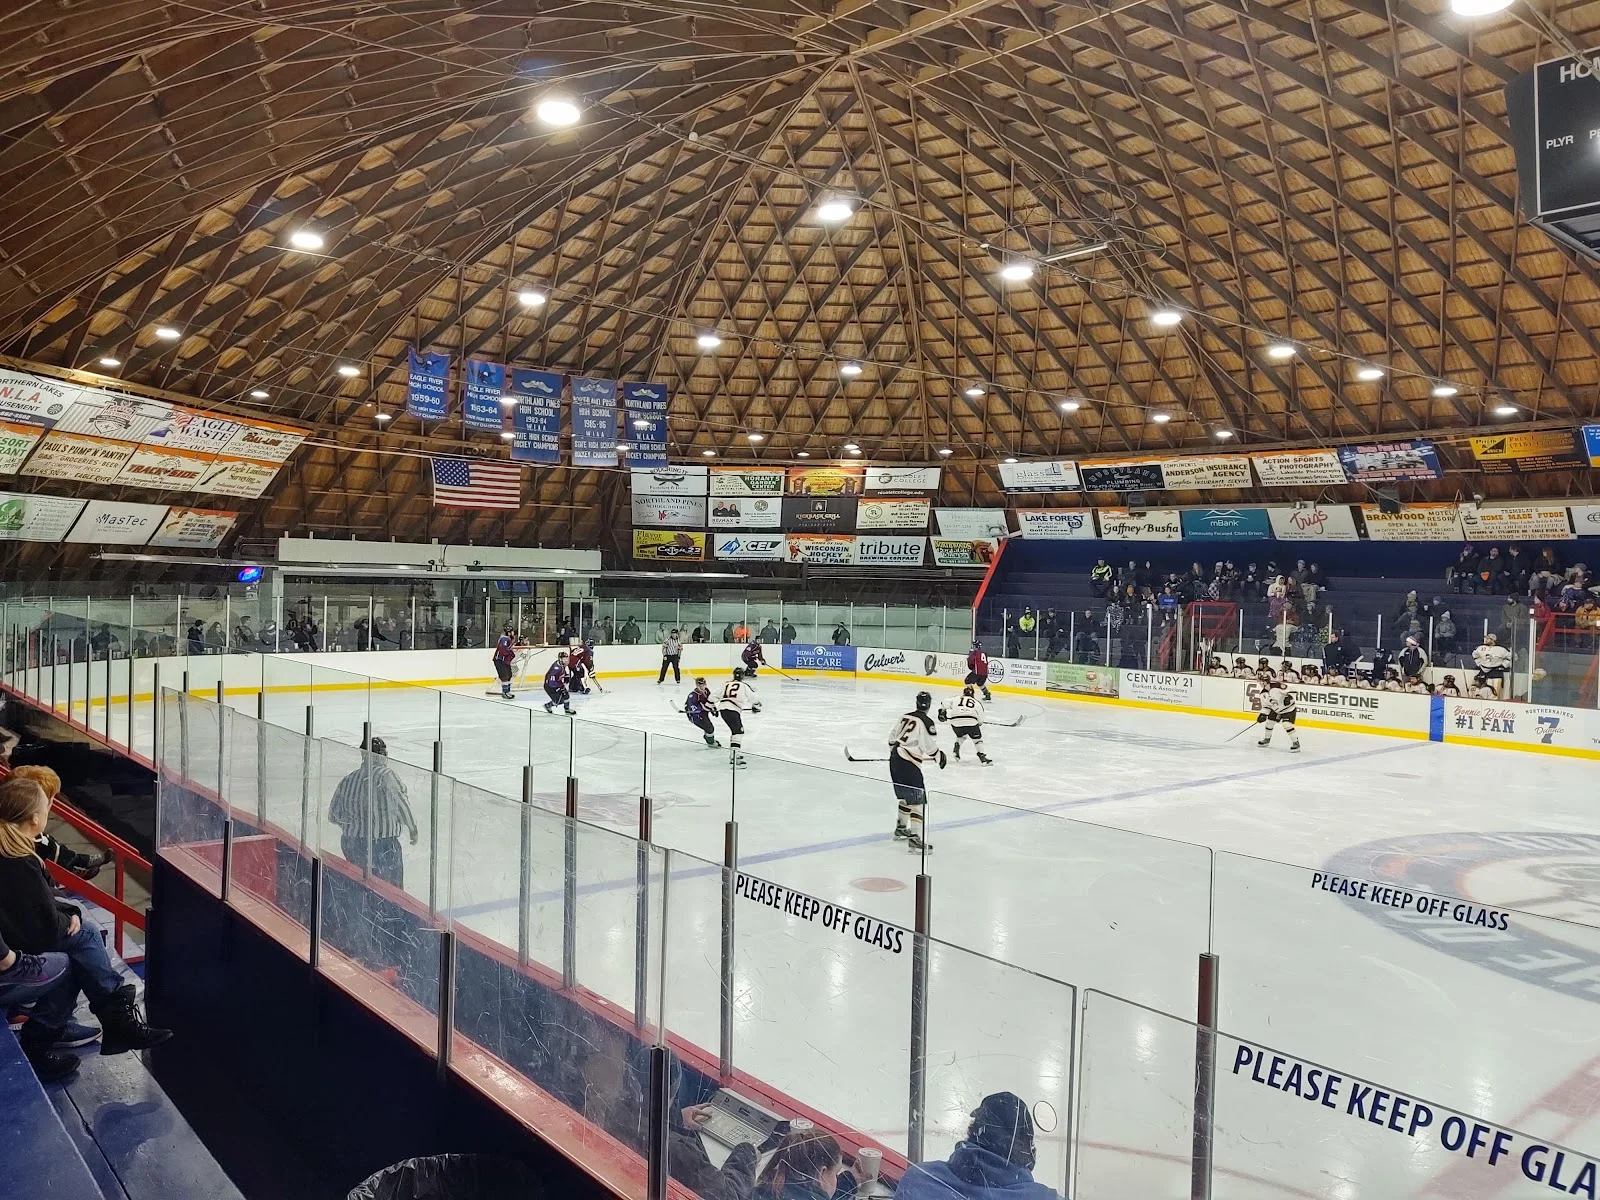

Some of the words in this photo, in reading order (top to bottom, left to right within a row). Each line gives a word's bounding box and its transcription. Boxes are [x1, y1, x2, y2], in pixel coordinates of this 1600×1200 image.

[1546, 135, 1574, 149] PLYR
[410, 374, 427, 382] EAGLE
[428, 377, 444, 385] RIVER
[39, 384, 65, 397] LAKES
[423, 383, 444, 392] SCHOOL
[468, 385, 484, 393] EAGLE
[0, 386, 42, 404] N.L.A.
[411, 394, 440, 405] 1959-60
[479, 394, 501, 402] SCHOOL
[0, 400, 40, 412] USEMENT
[514, 395, 544, 406] NORTHLAND
[545, 399, 561, 408] PINES
[603, 398, 616, 406] PINES
[624, 399, 651, 409] NORTHLAND
[652, 401, 667, 410] PINES
[470, 404, 498, 414] 1963-64
[519, 405, 531, 414] HIGH
[534, 407, 555, 417] SCHOOL
[579, 408, 590, 416] HIGH
[591, 408, 611, 417] SCHOOL
[629, 411, 641, 419] HIGH
[642, 411, 663, 420] SCHOOL
[187, 416, 237, 432] EAGLE
[584, 420, 607, 429] 1985-86
[180, 426, 231, 442] WASTE
[514, 432, 527, 440] STATE
[542, 434, 558, 443] SCHOOL
[0, 437, 32, 448] SORT
[513, 440, 531, 449] HOCKEY
[533, 442, 558, 450] CHAMPIONS
[574, 440, 587, 448] STATE
[600, 441, 617, 449] SCHOOL
[640, 442, 650, 450] HIGH
[650, 443, 667, 451] SCHOOL
[41, 441, 67, 453] PAUL'S
[68, 445, 92, 457] PUMP
[100, 450, 129, 461] PANTRY
[592, 451, 618, 459] CHAMPIONS
[642, 452, 667, 460] CHAMPIONS
[59, 456, 100, 466] GROCERIES
[1279, 462, 1335, 470] PHOTOGRAPHY
[229, 465, 246, 474] Eagle
[1016, 471, 1046, 479] glass
[1088, 467, 1158, 482] MUSKYLAND
[1165, 467, 1205, 477] ANDERSON
[682, 500, 704, 508] PINES
[98, 513, 148, 526] MasTec
[1049, 515, 1085, 528] FOREST
[1366, 513, 1425, 521] BRAYWOOD
[1210, 519, 1239, 527] mBank
[1103, 522, 1179, 536] Gaffney-Busha
[860, 541, 921, 555] tribute
[796, 658, 815, 667] EYE
[816, 658, 842, 667] CARE
[864, 651, 906, 671] Culver's
[980, 652, 988, 664] 4
[938, 660, 959, 669] EAGLE
[952, 668, 966, 676] TIRE
[1126, 672, 1180, 686] CENTURY
[1183, 678, 1193, 687] 21
[722, 683, 740, 698] 12
[1158, 685, 1188, 693] Associates
[957, 697, 976, 709] 16
[1293, 691, 1379, 708] NERSTONE
[1311, 708, 1355, 719] BUILDERS,
[1359, 713, 1375, 721] INC.
[1454, 705, 1481, 717] Bonnie
[1525, 708, 1574, 719] NORTHERNAIRES
[1455, 715, 1474, 729] #1
[1481, 717, 1515, 733] FAN
[899, 717, 917, 743] 72
[1538, 716, 1560, 744] 7
[1311, 872, 1368, 900] PLEASE
[1370, 885, 1414, 909] KEEP
[1416, 896, 1450, 918] OFF
[1452, 904, 1510, 931] GLASS
[735, 874, 783, 909] PLEASE
[784, 891, 820, 921] KEEP
[822, 905, 851, 933] OFF
[854, 916, 904, 954] GLASS
[1232, 1044, 1342, 1109] PLEASE
[1346, 1083, 1434, 1138] KEEP
[1440, 1116, 1514, 1166] OFF
[1521, 1144, 1600, 1200] GLA
